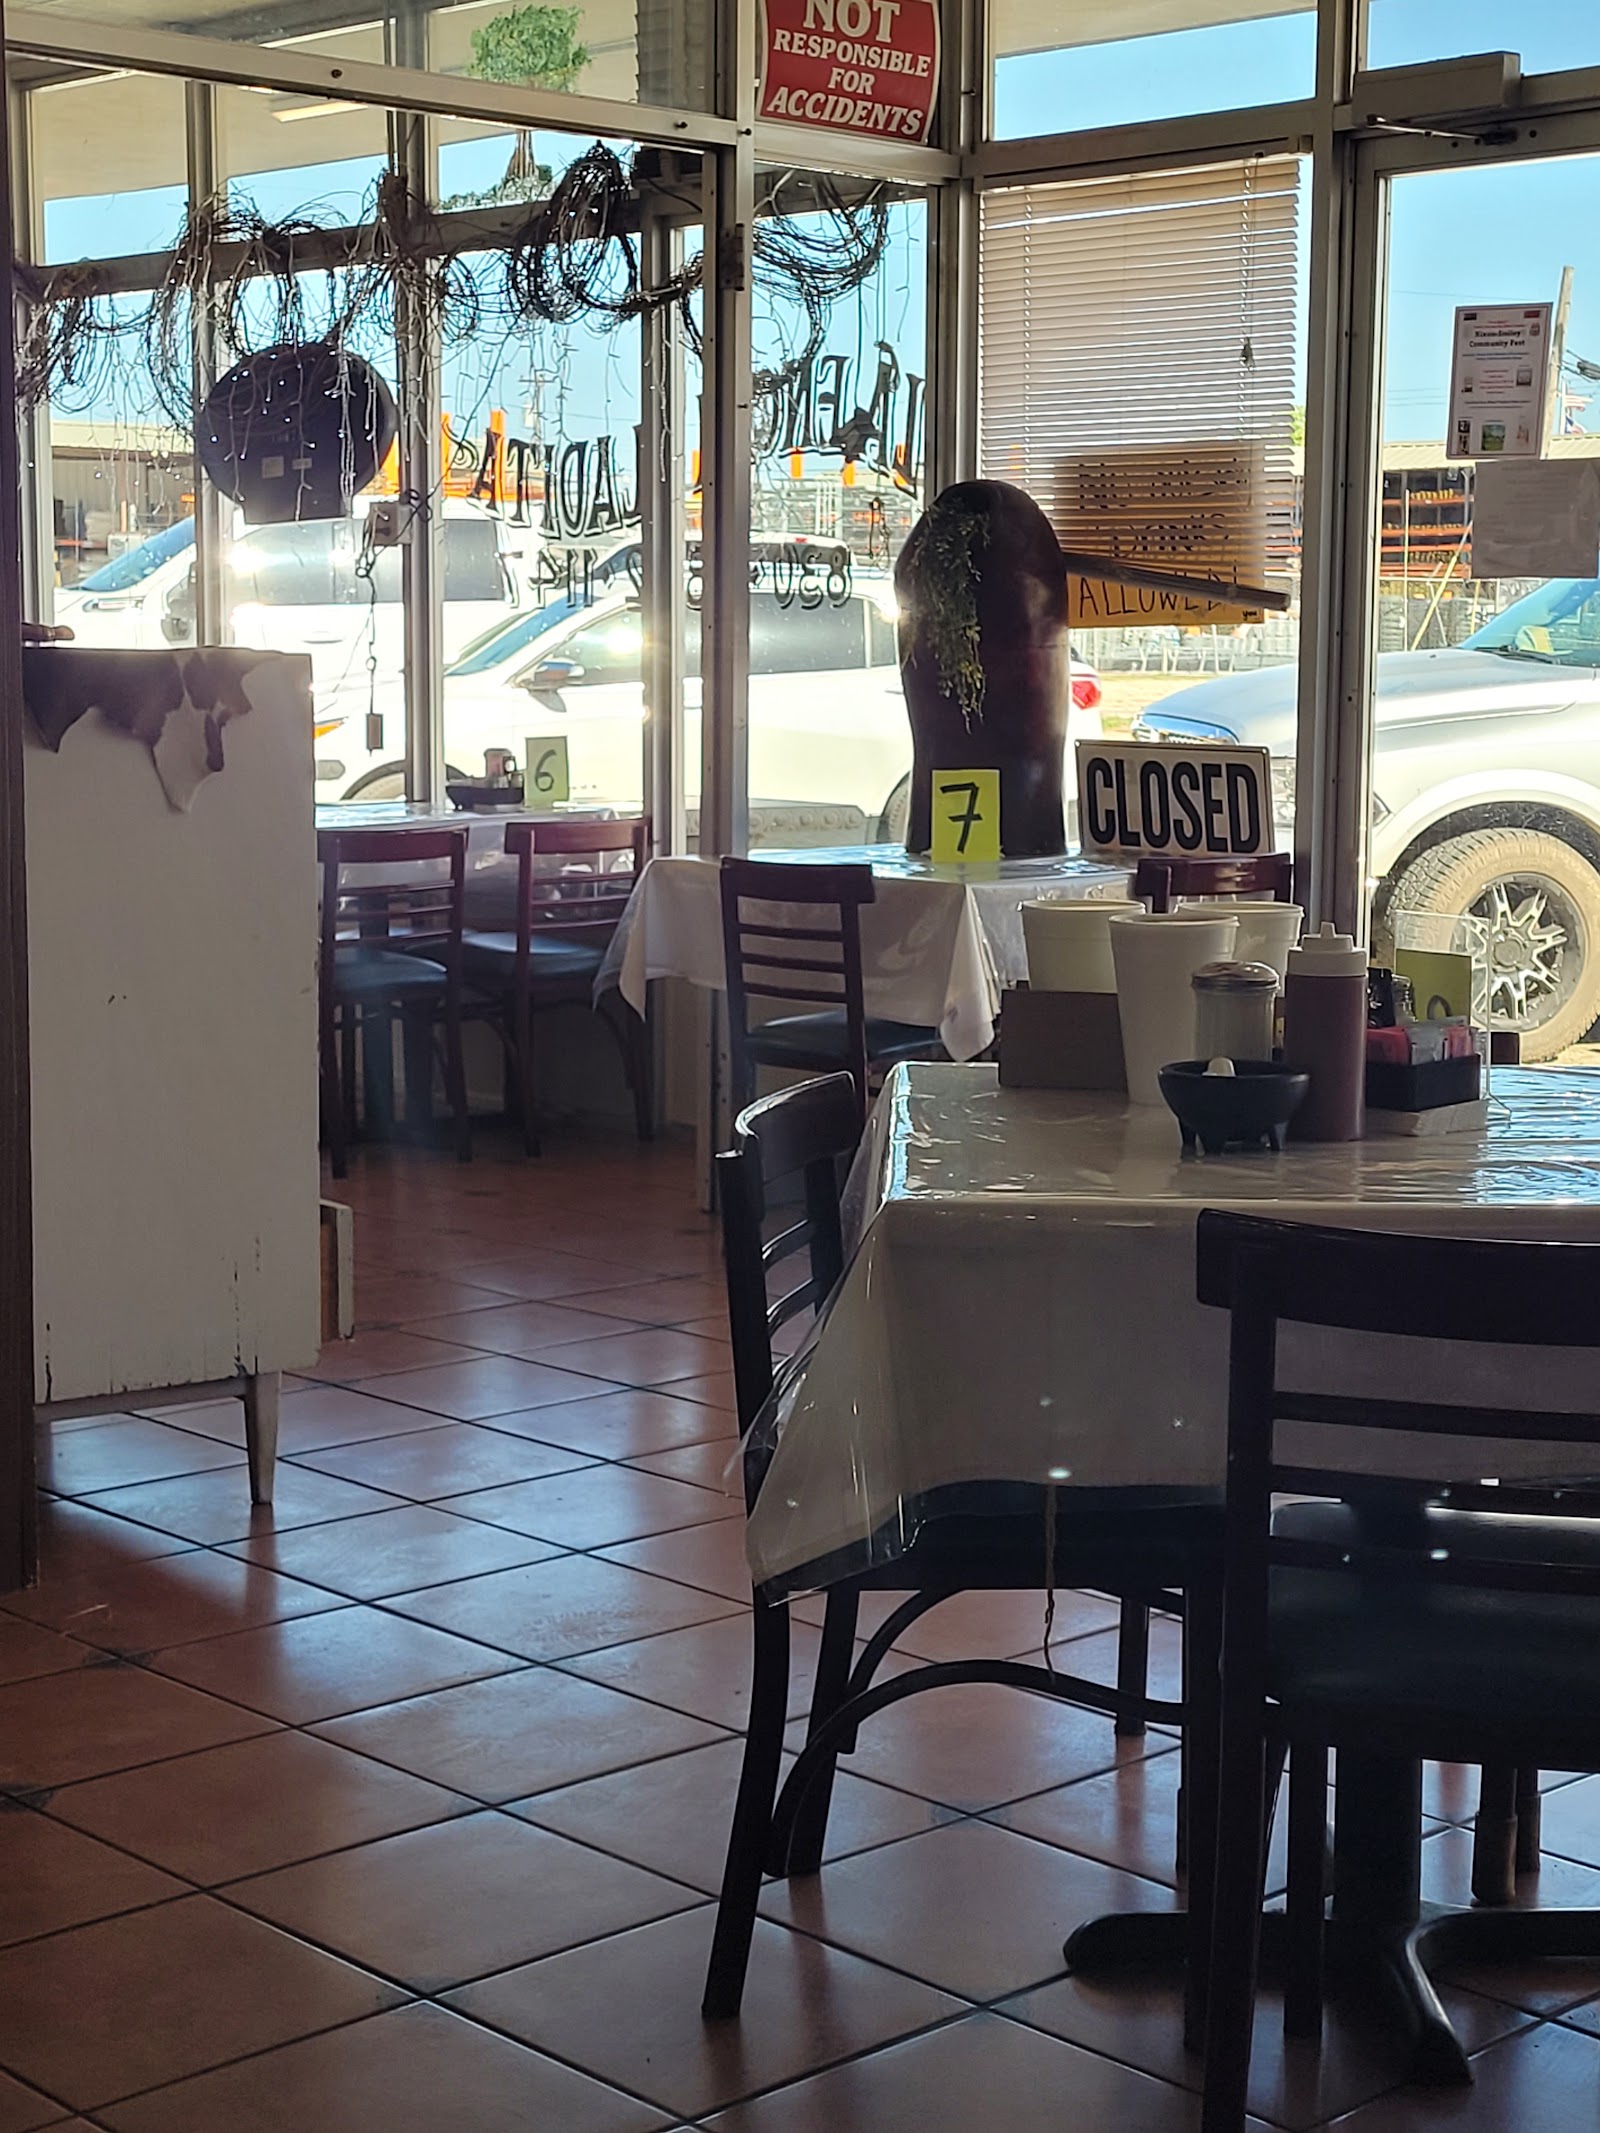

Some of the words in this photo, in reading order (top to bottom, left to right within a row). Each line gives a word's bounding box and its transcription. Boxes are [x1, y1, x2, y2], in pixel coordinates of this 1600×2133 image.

[803, 0, 900, 43] NOT
[773, 29, 931, 77] RESPONSIBLE
[828, 67, 875, 95] FOR
[766, 87, 923, 136] ACCIDENTS
[1469, 340, 1508, 349] Community
[535, 749, 557, 792] 6
[940, 782, 983, 854] 7
[1086, 757, 1260, 853] CLOSED
